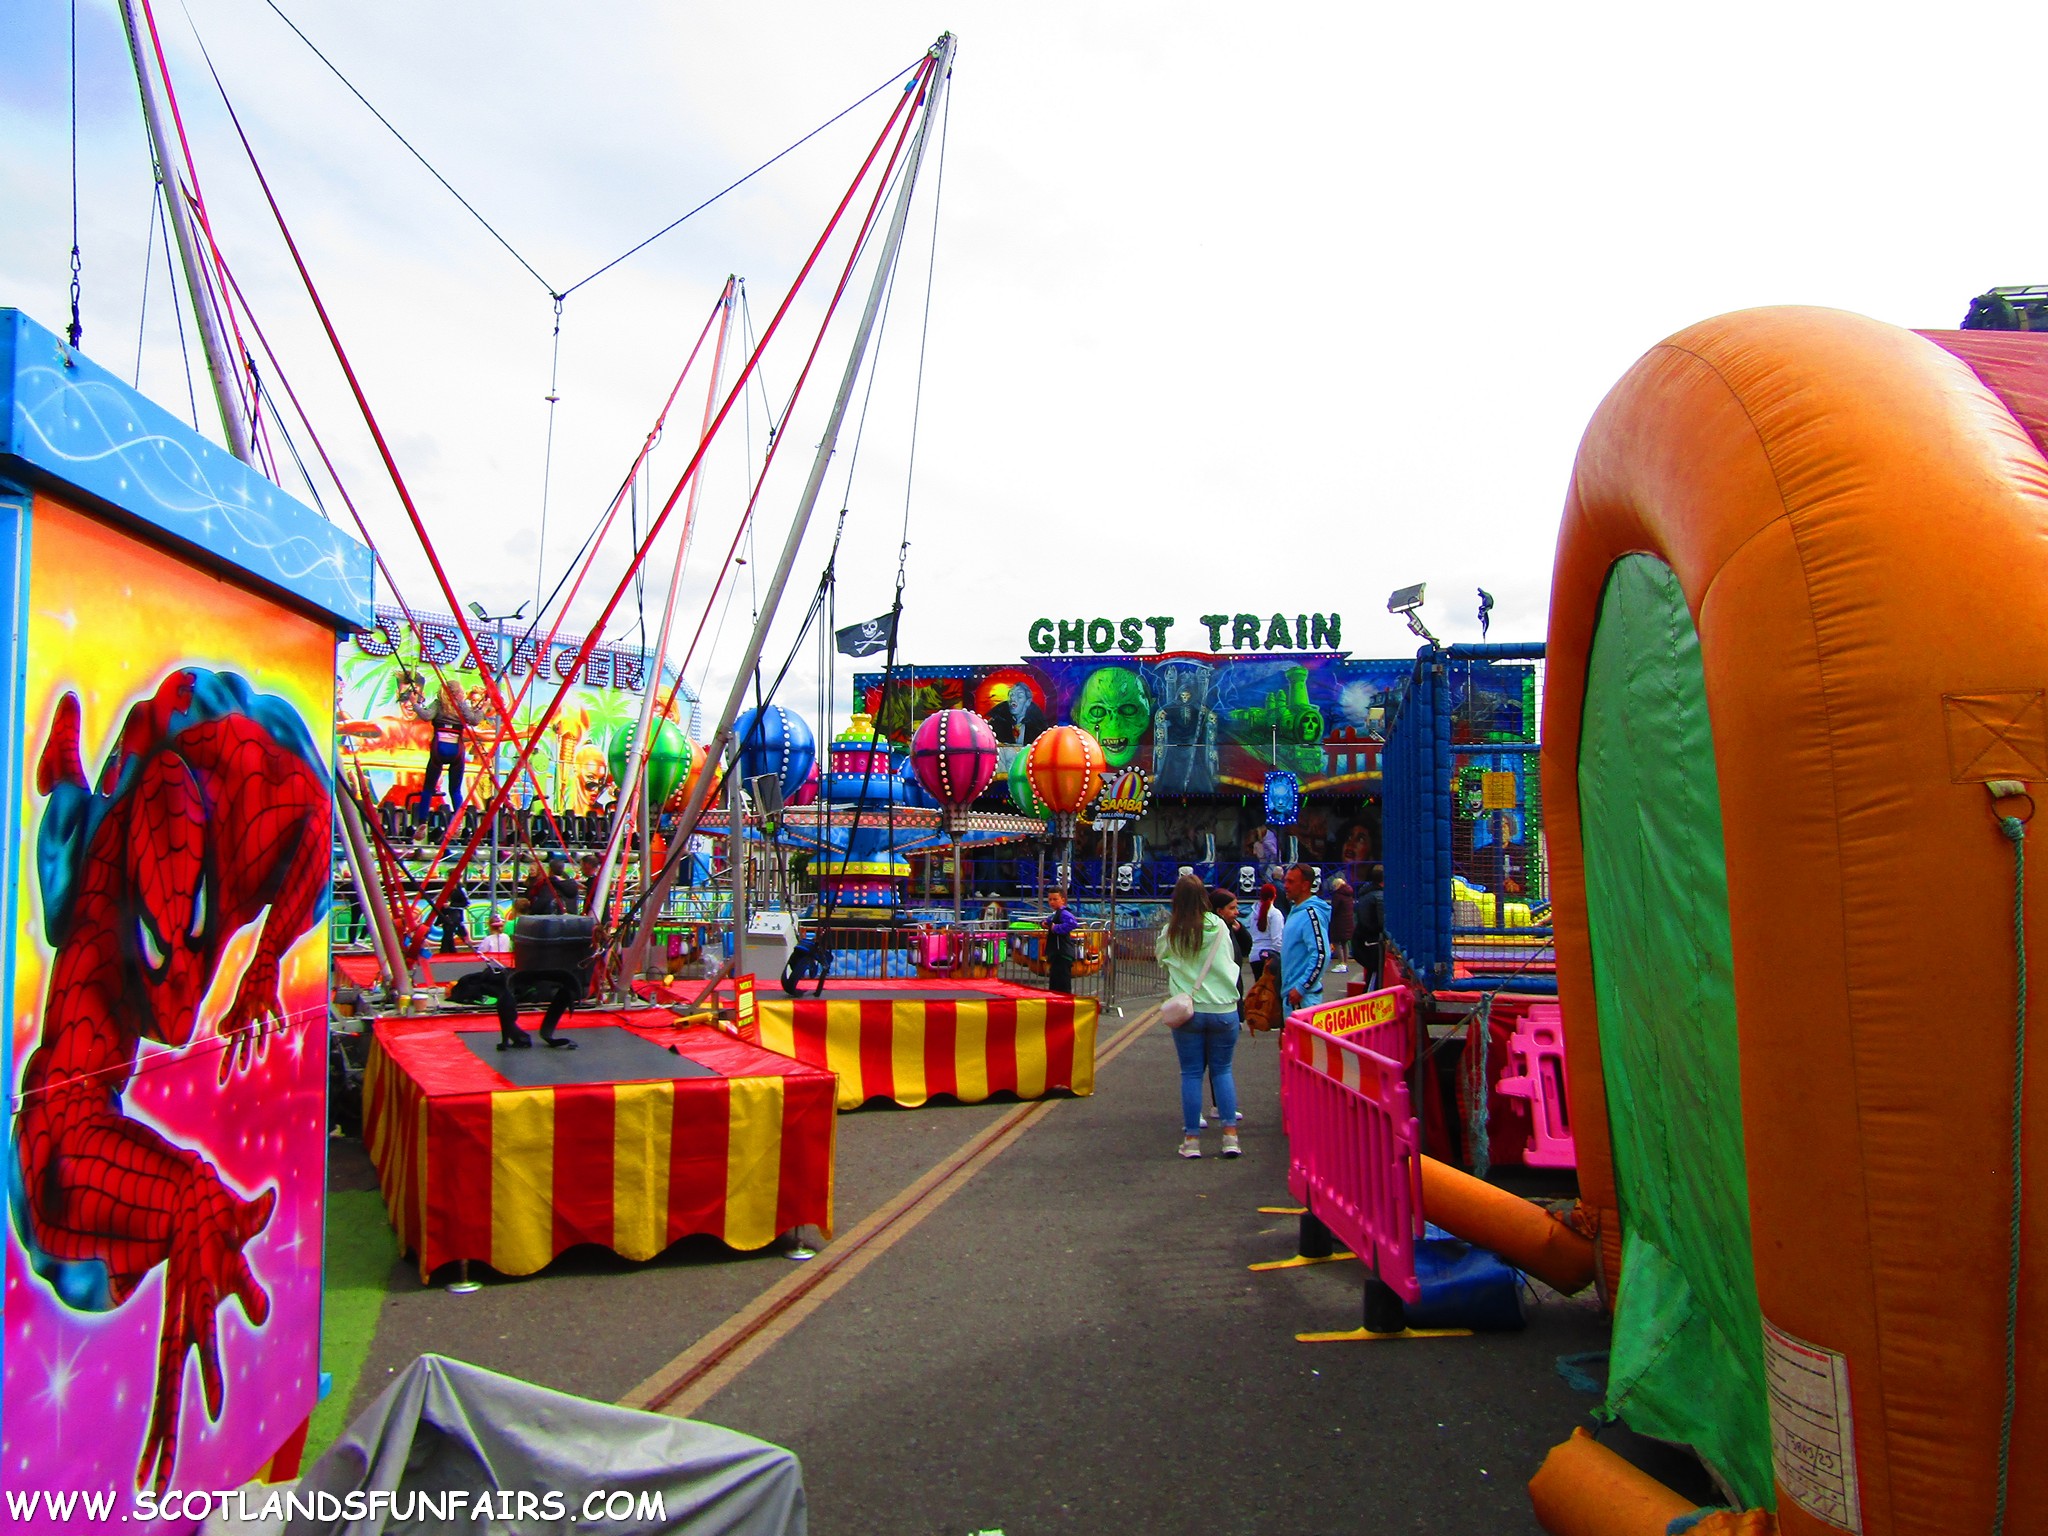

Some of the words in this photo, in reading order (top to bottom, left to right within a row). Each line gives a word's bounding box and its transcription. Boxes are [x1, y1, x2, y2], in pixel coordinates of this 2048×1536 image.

[1028, 616, 1175, 654] GHOST
[1200, 612, 1342, 652] TRAIN
[1100, 799, 1143, 813] SAMBA
[1324, 1001, 1376, 1034] GIGANTIC
